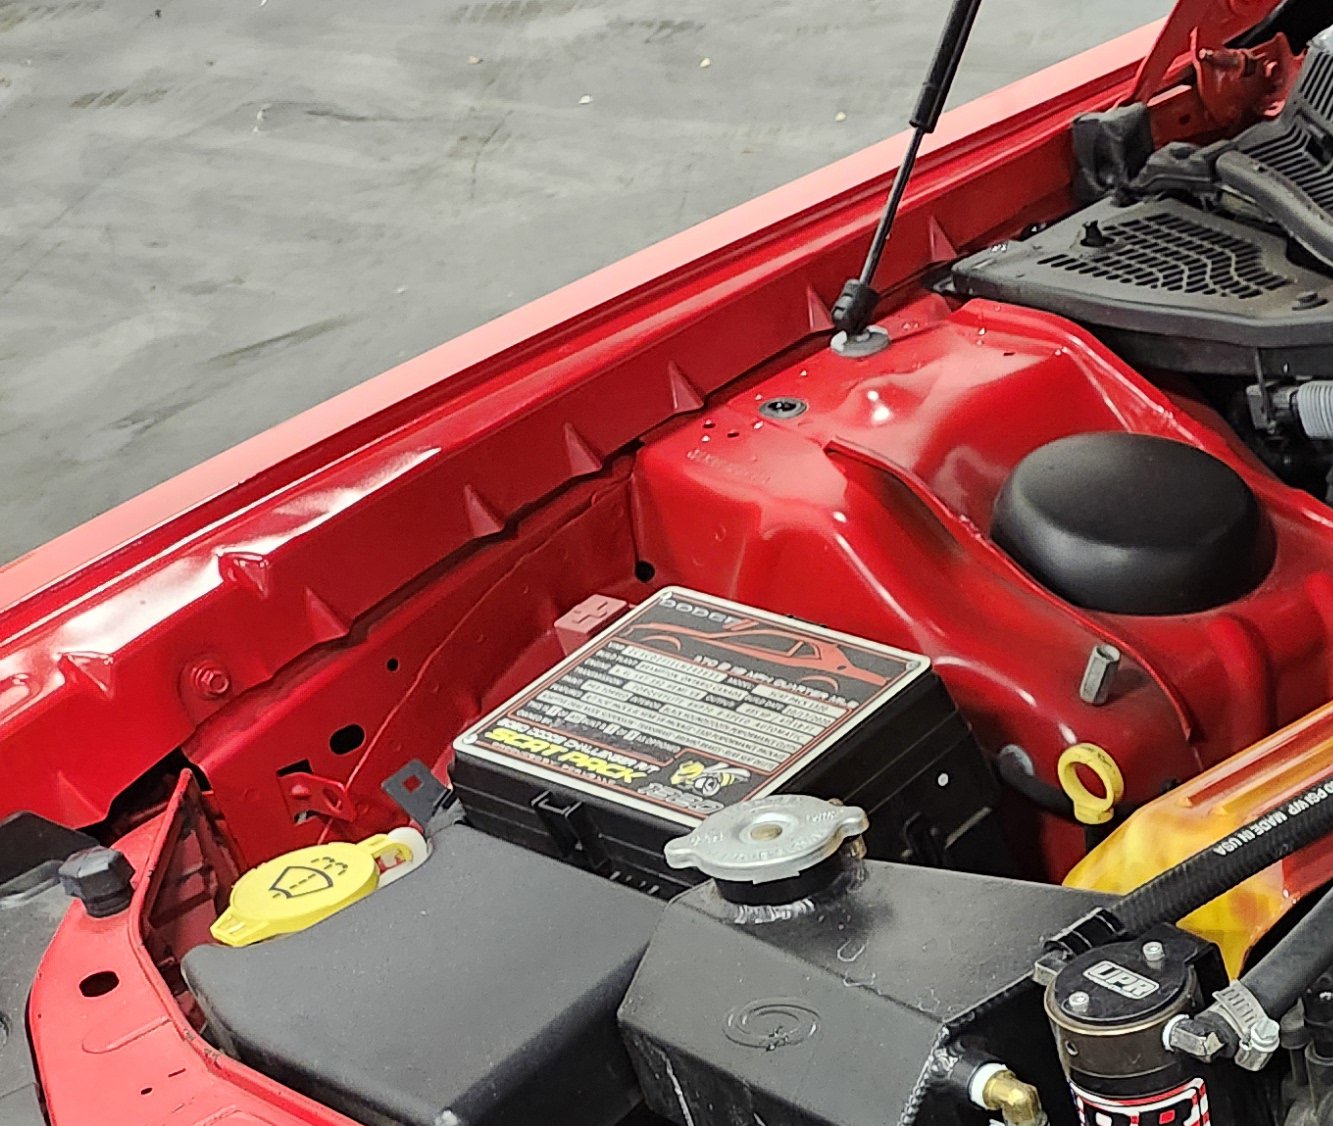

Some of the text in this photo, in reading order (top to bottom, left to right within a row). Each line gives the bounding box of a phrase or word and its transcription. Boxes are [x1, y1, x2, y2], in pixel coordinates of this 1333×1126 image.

[754, 721, 805, 741] AUTOMATIC
[485, 728, 568, 756] SCAT
[558, 751, 643, 783] PACK
[564, 738, 637, 767] CHALLENGER
[1308, 786, 1328, 801] PSI
[1253, 812, 1288, 835] MADE
[1213, 836, 1243, 856] USA
[1241, 829, 1255, 843] IN
[1088, 962, 1157, 998] UPR
